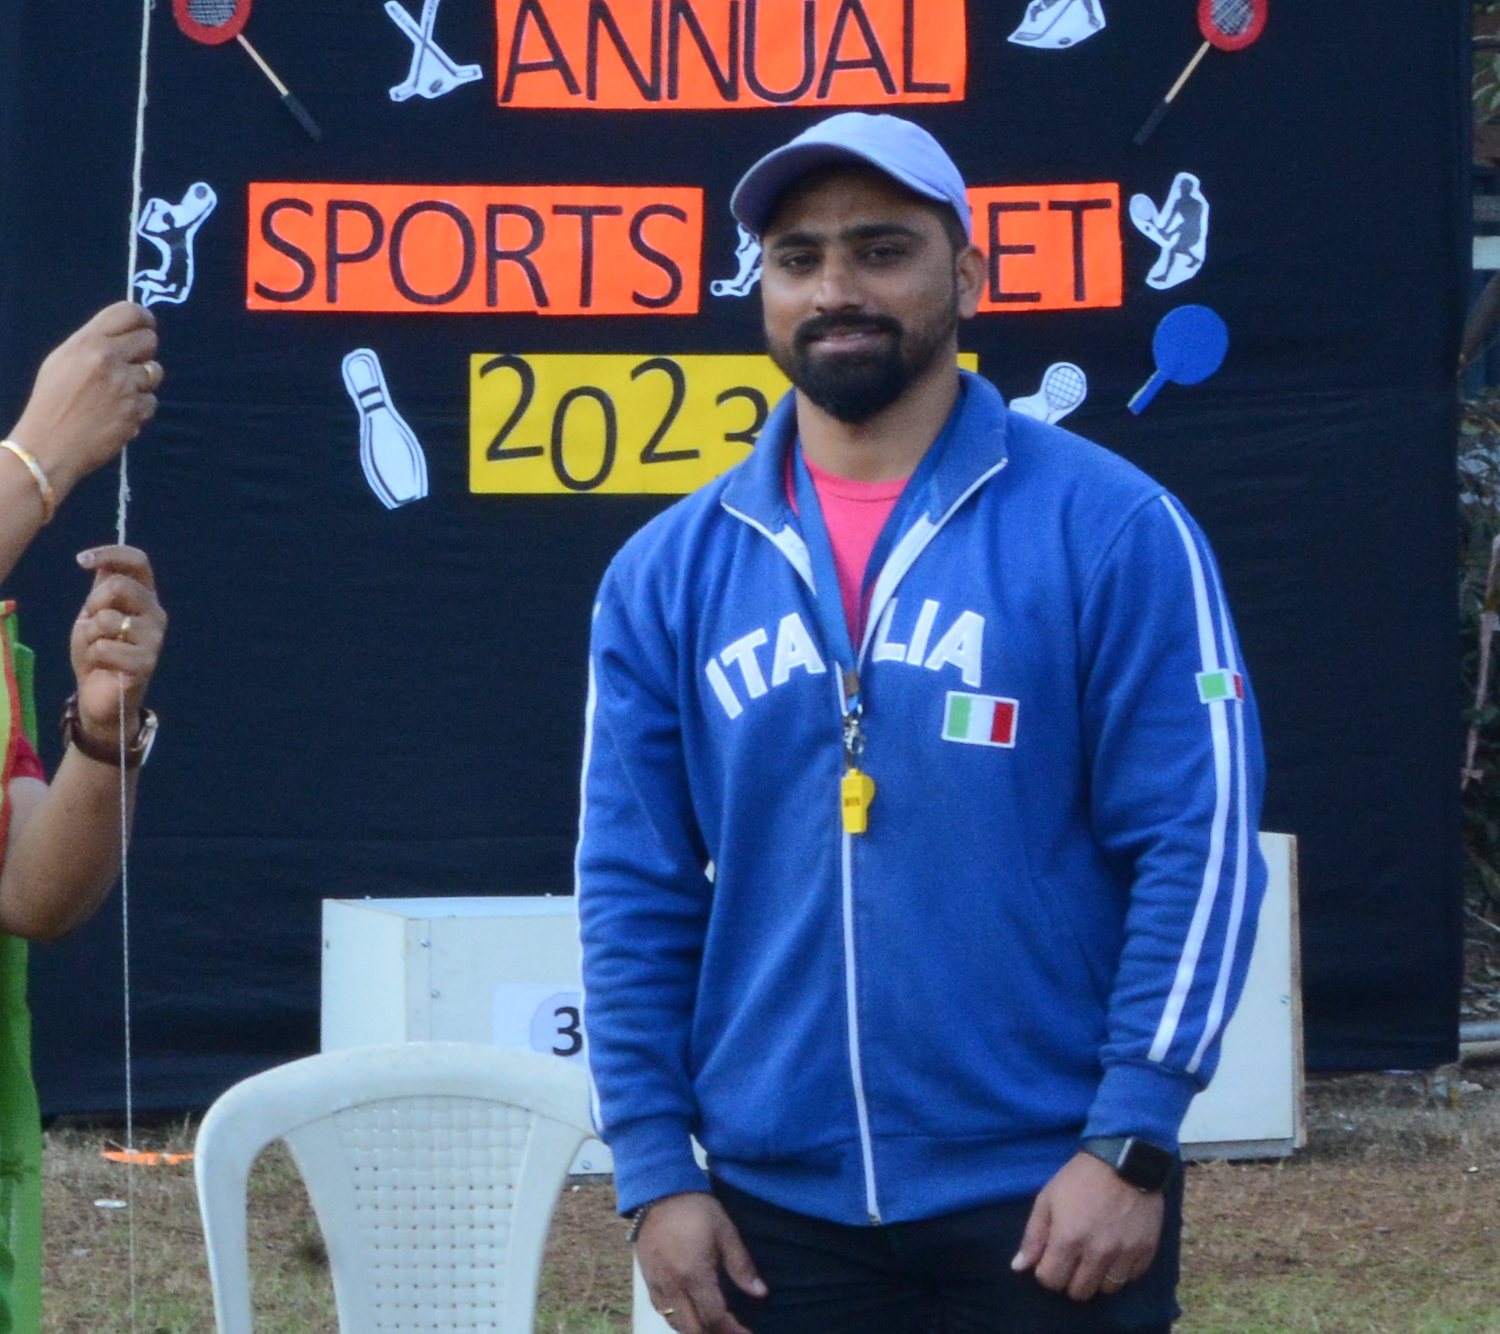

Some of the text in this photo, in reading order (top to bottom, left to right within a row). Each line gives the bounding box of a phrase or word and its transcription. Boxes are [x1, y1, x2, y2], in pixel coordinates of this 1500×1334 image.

[254, 197, 1112, 309] SPORTS ET
[704, 597, 986, 720] ITALIA
[552, 1005, 583, 1058] 3
